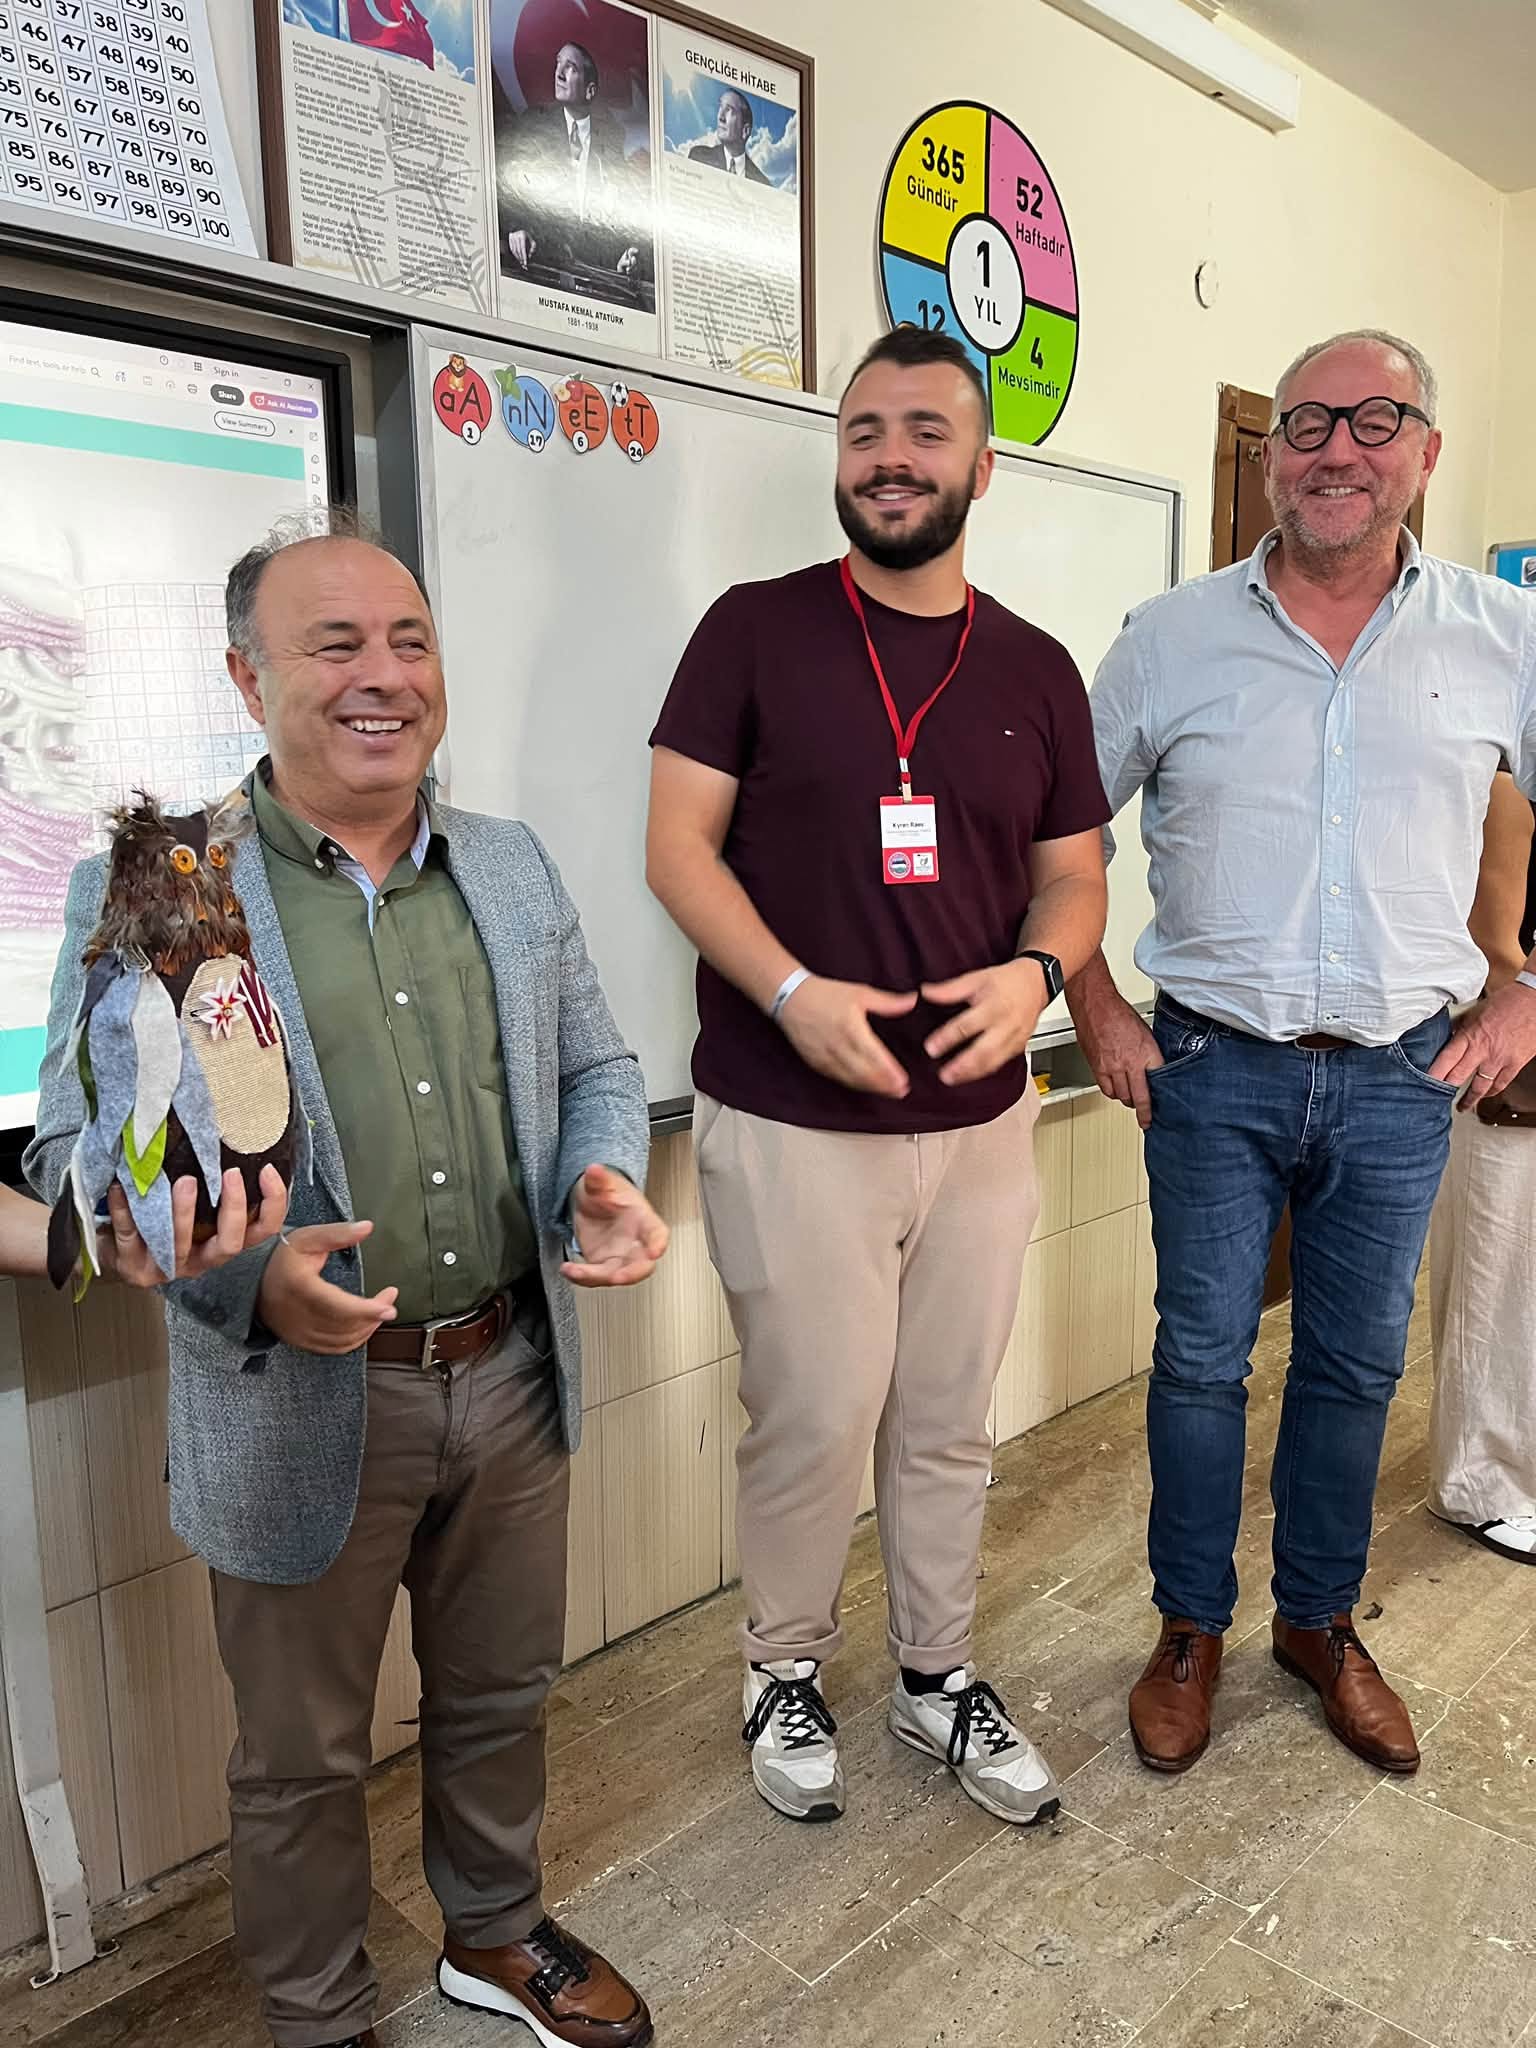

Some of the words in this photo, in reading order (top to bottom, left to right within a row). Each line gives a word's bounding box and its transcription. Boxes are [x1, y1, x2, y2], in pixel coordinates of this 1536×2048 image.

[19, 0, 41, 8] 6
[56, 0, 80, 19] 37
[94, 12, 118, 31] 38
[130, 24, 153, 41] 39
[165, 35, 188, 53] 40
[161, 3, 183, 21] 30
[21, 22, 48, 41] 46
[61, 34, 85, 52] 47
[98, 45, 123, 64] 48
[135, 56, 159, 73] 49
[171, 65, 194, 84] 50
[0, 46, 14, 62] 5
[27, 53, 54, 74] 56
[67, 65, 91, 83] 57
[104, 75, 129, 95] 58
[140, 86, 164, 105] 59
[177, 98, 200, 115] 60
[685, 48, 738, 82] GENÇLİĞE
[740, 71, 777, 96] HİTABE
[34, 88, 61, 106] 66
[74, 98, 98, 115] 67
[111, 108, 136, 126] 68
[148, 118, 170, 135] 69
[181, 127, 206, 145] 70
[0, 107, 28, 127] 75
[39, 117, 67, 138] 76
[79, 128, 104, 147] 77
[116, 138, 142, 157] 78
[152, 148, 177, 165] 79
[190, 158, 213, 175] 80
[8, 141, 35, 160] 85
[48, 151, 74, 170] 86
[87, 160, 112, 178] 87
[125, 170, 149, 188] 88
[161, 179, 184, 196] 89
[196, 188, 220, 206] 90
[921, 137, 965, 185] 365
[14, 173, 42, 192] 95
[54, 182, 81, 201] 96
[93, 191, 118, 209] 97
[131, 200, 157, 218] 98
[167, 209, 192, 227] 99
[202, 218, 229, 238] 100
[907, 175, 959, 213] Gündür
[1016, 176, 1043, 219] 52
[1016, 221, 1065, 258] Haftadır
[977, 240, 991, 288] 1
[538, 296, 569, 311] MUSTAFA
[571, 304, 594, 317] KEMAL
[595, 311, 623, 325] ATATÜRK
[917, 299, 946, 332] 12
[974, 296, 1002, 326] YIL
[9, 354, 24, 365] Find
[1030, 337, 1044, 369] 4
[213, 366, 230, 378] Sign
[232, 369, 239, 377] in
[998, 365, 1061, 401] Mevsimdir
[218, 390, 236, 401] Share
[222, 416, 235, 426] View
[237, 418, 268, 432] Summary
[466, 427, 474, 439] 1
[529, 434, 542, 447] 17
[577, 436, 584, 447] 6
[630, 446, 642, 458] 24
